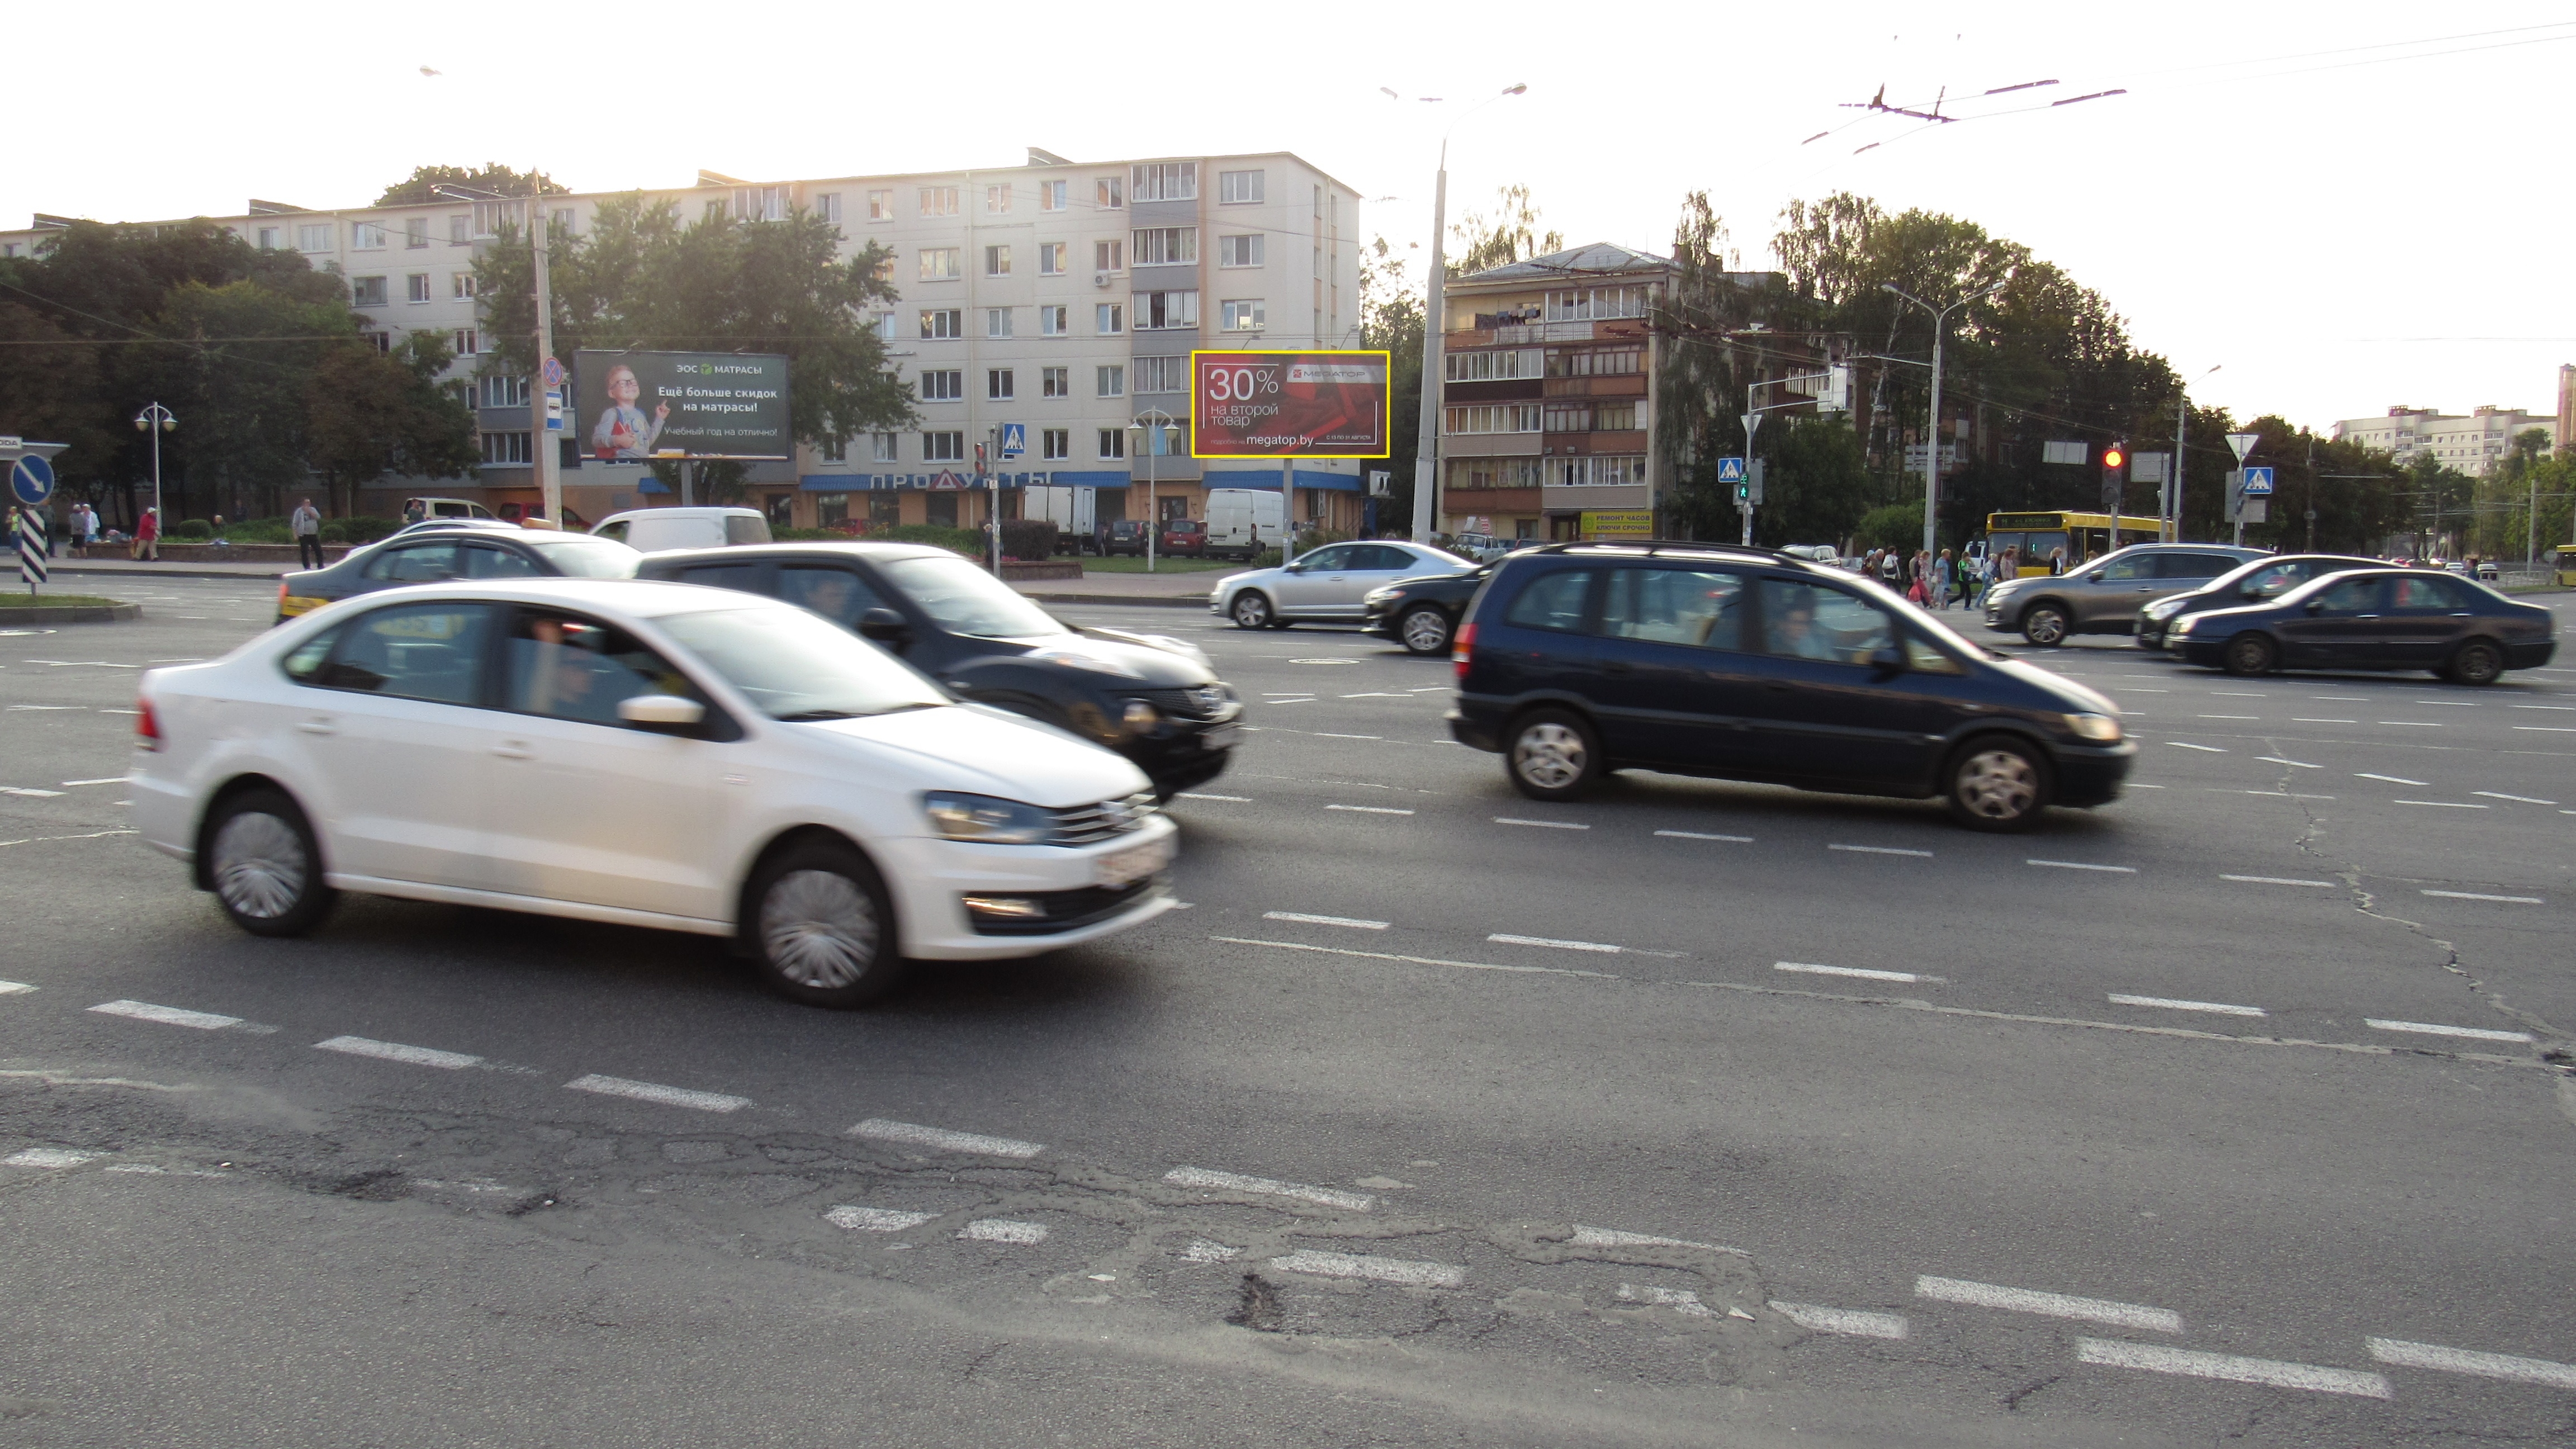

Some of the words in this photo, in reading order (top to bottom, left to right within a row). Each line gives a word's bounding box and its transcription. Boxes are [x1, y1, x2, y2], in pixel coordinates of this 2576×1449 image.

[676, 364, 698, 373] ЭОС
[714, 366, 762, 375] МАТРАСЫ
[1209, 368, 1279, 401] 30%
[659, 386, 683, 399] Ещё
[686, 387, 731, 397] больше
[735, 390, 778, 399] скидок
[683, 402, 698, 411] на
[702, 402, 759, 414] матрасы!
[1211, 406, 1229, 415] на
[1231, 403, 1278, 418] второй
[1211, 416, 1250, 428] товар
[664, 427, 704, 435] Учебный
[738, 428, 778, 437] отлично!
[1247, 435, 1314, 447] megatop.by
[870, 472, 1052, 489] ПРОДУТЫ
